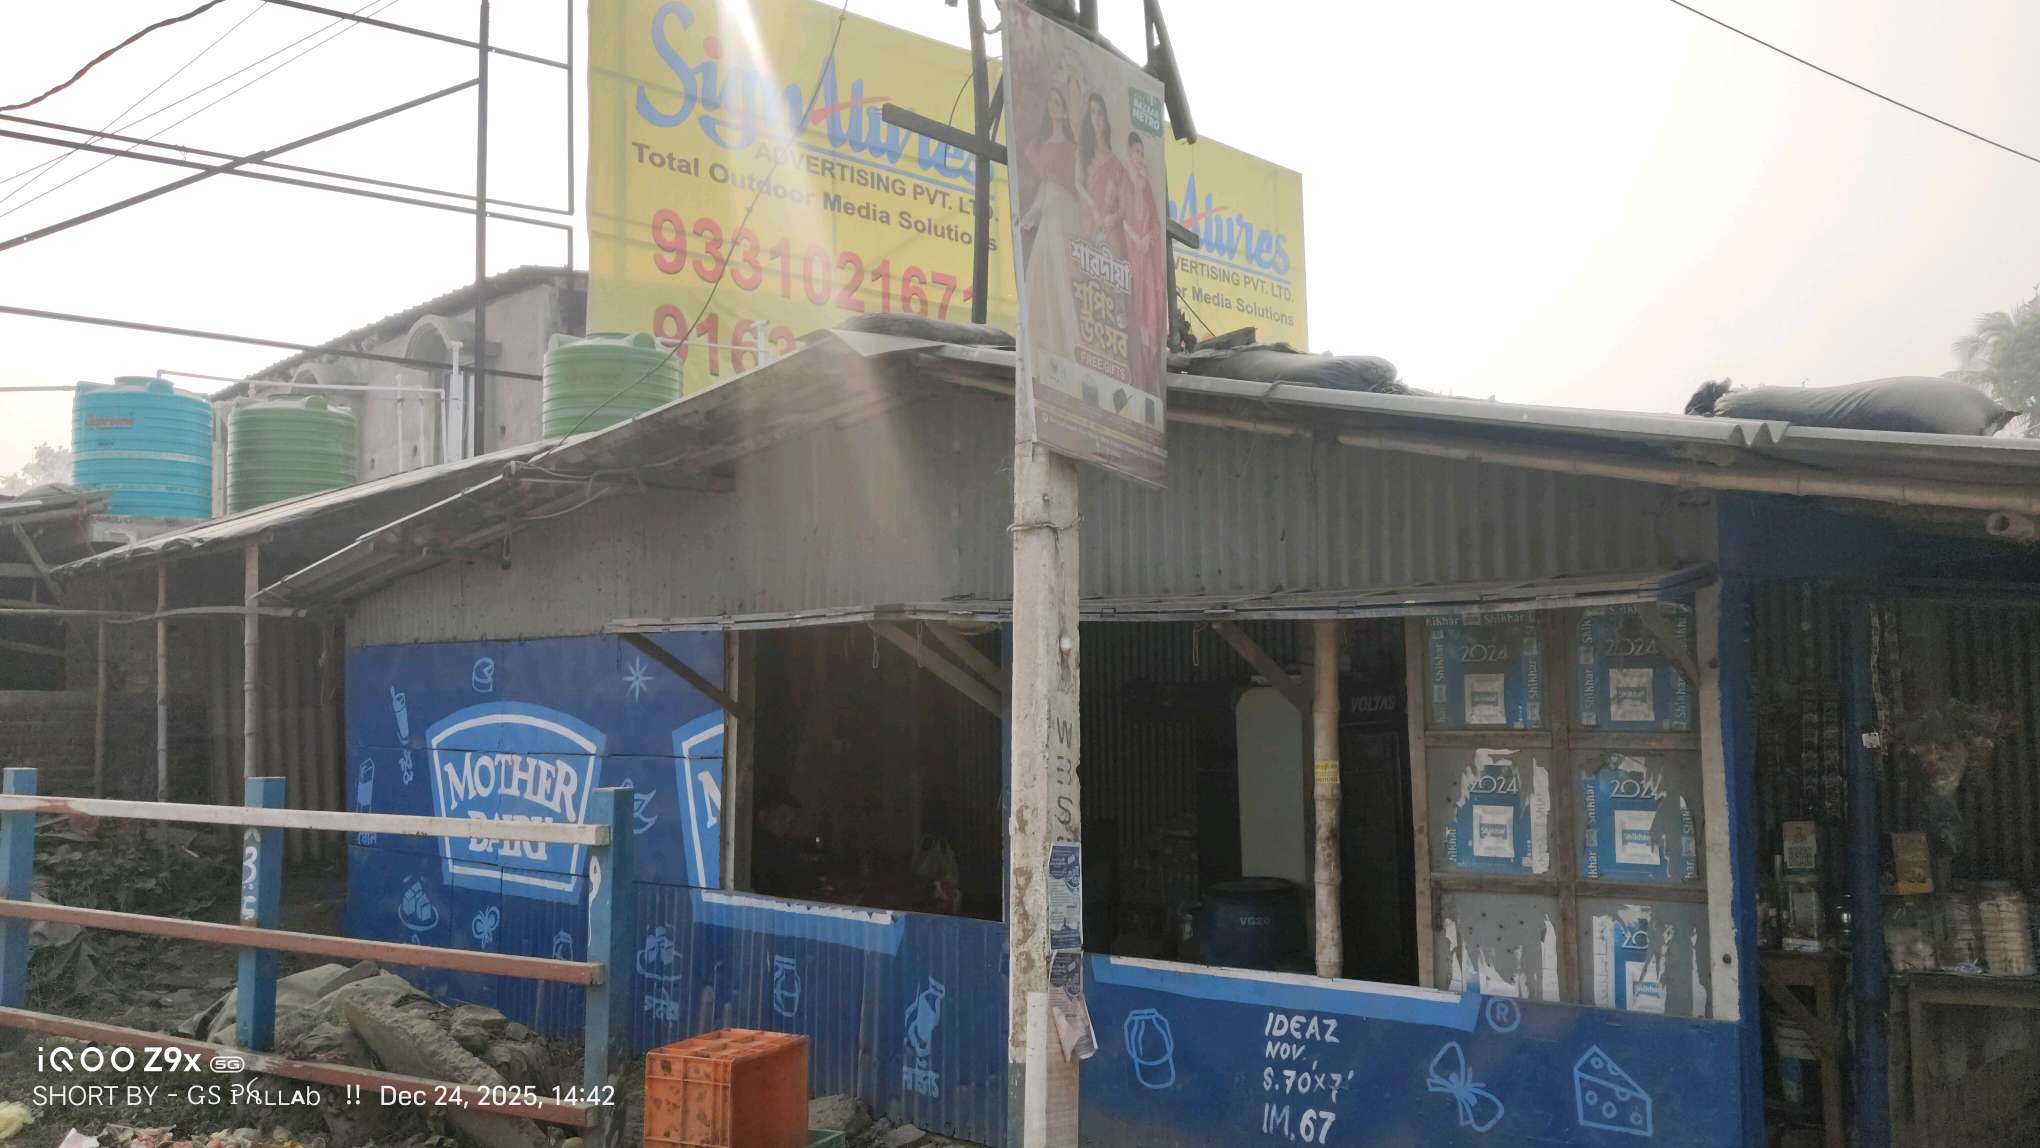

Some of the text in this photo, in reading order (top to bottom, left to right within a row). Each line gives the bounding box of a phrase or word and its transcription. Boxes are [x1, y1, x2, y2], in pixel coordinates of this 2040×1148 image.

[632, 141, 998, 251] Total Outdoor Media Solutios
[755, 142, 906, 197] ADVERTISING
[912, 184, 953, 210] PVT.
[1192, 285, 1233, 310] Media
[1236, 297, 1295, 326] Solutions
[1243, 278, 1270, 295] PVT.
[1270, 281, 1295, 304] LTD.
[1461, 643, 1509, 662] 2024
[444, 751, 578, 822] MOTHER
[1264, 1012, 1340, 1043] IDEAZ
